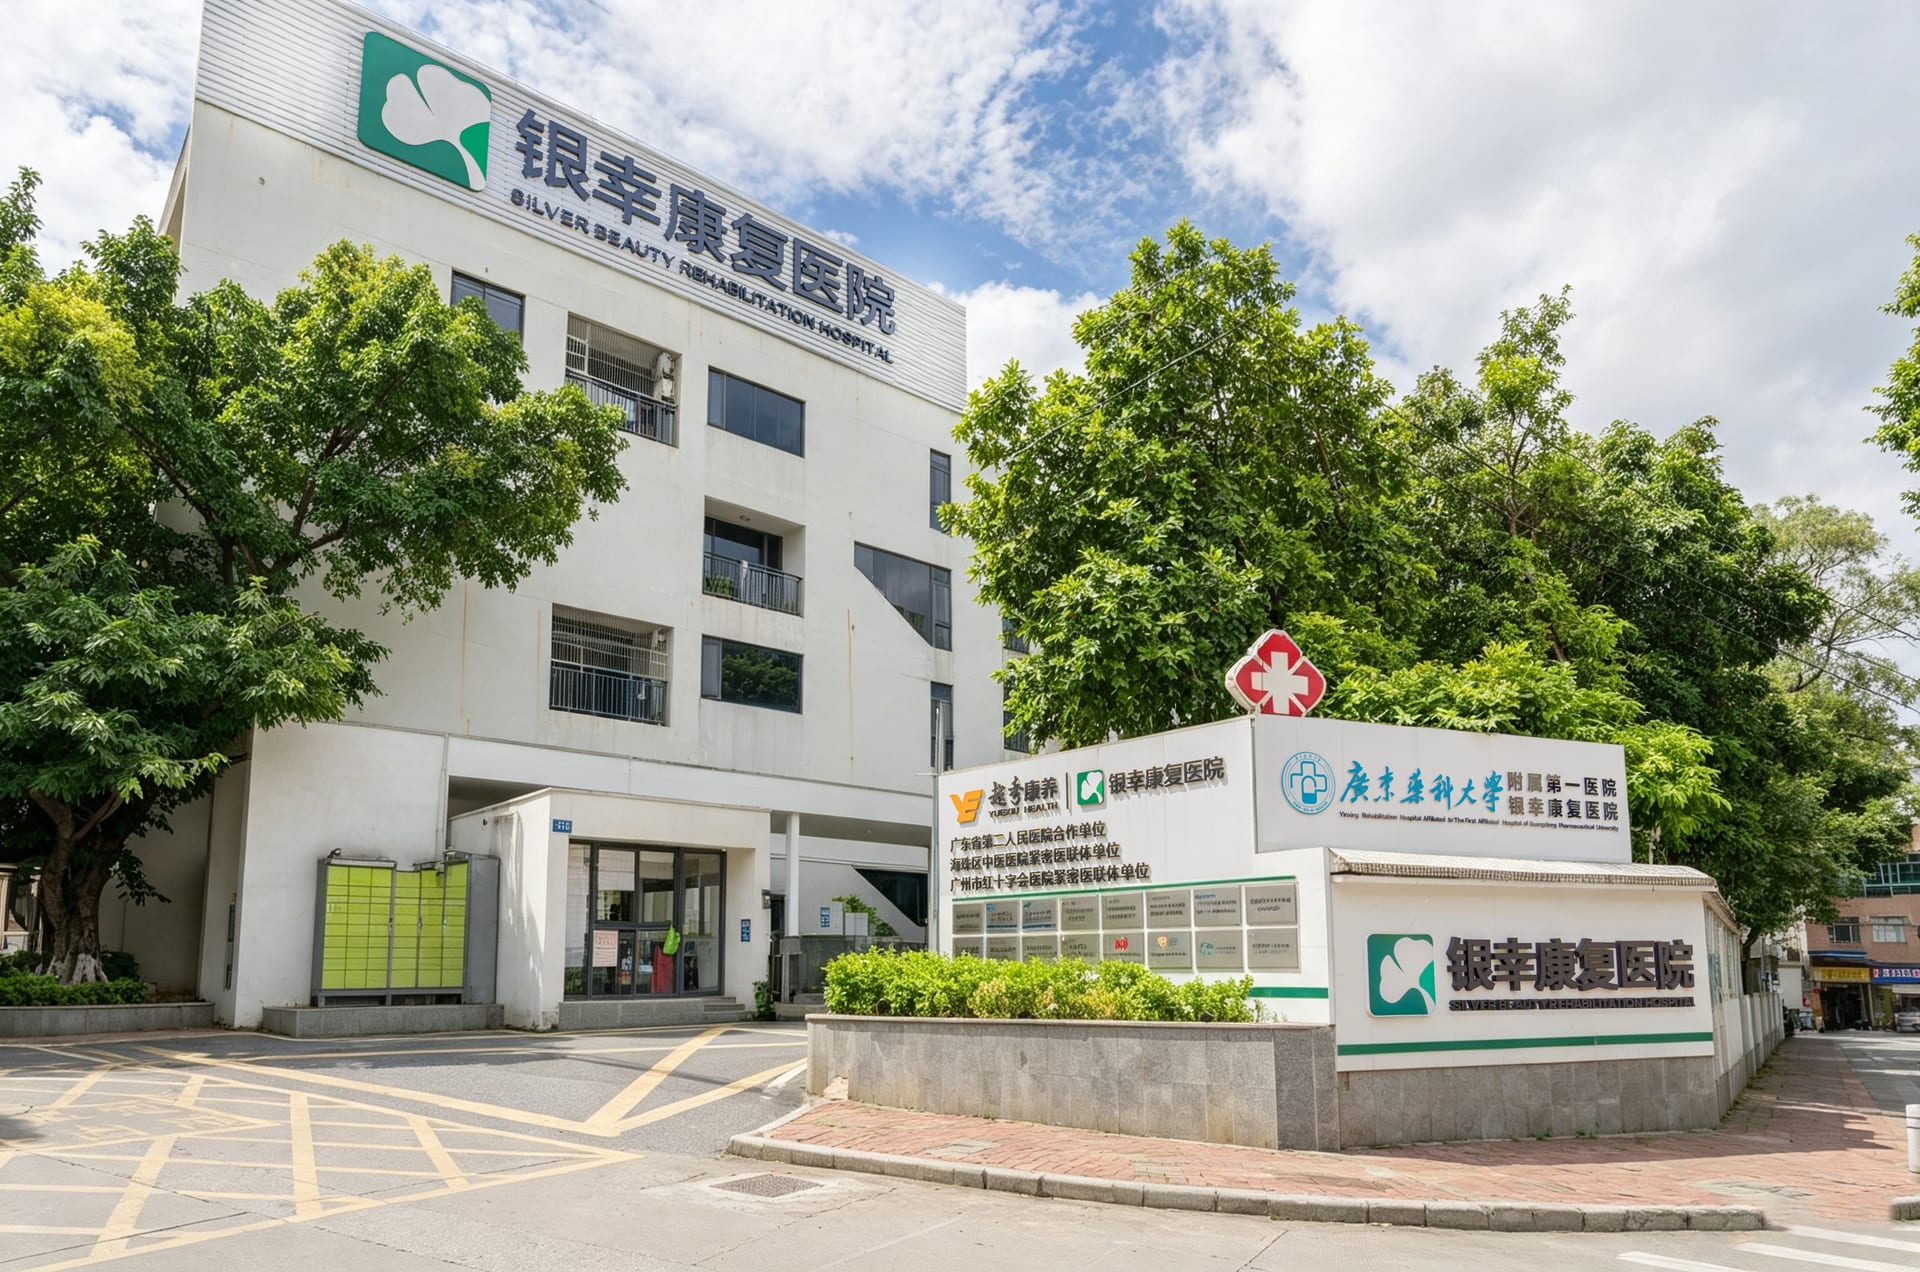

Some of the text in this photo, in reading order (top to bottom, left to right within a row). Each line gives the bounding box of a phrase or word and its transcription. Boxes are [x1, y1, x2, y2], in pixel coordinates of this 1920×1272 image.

[515, 108, 896, 335] 银幸康复医院
[510, 188, 895, 365] SILVER BEAUTY REHABILITATION HOSPITAL
[987, 775, 1059, 806] 越秀康养
[1108, 756, 1226, 795] 银幸康复医院
[1507, 771, 1618, 798] 附属第一医院
[988, 801, 1059, 818] YUEXIU HEALTH
[1399, 813, 1422, 823] Hospital
[1508, 795, 1620, 821] 银幸康复医院
[950, 820, 1106, 852] 广东省第二人民医院合作单位
[950, 842, 1121, 872] 海珠区中医医院紧密医联体单位
[950, 862, 1150, 892] 广州市红十字会医院紧密医联体单位
[1446, 936, 1695, 991] 银幸康复医院
